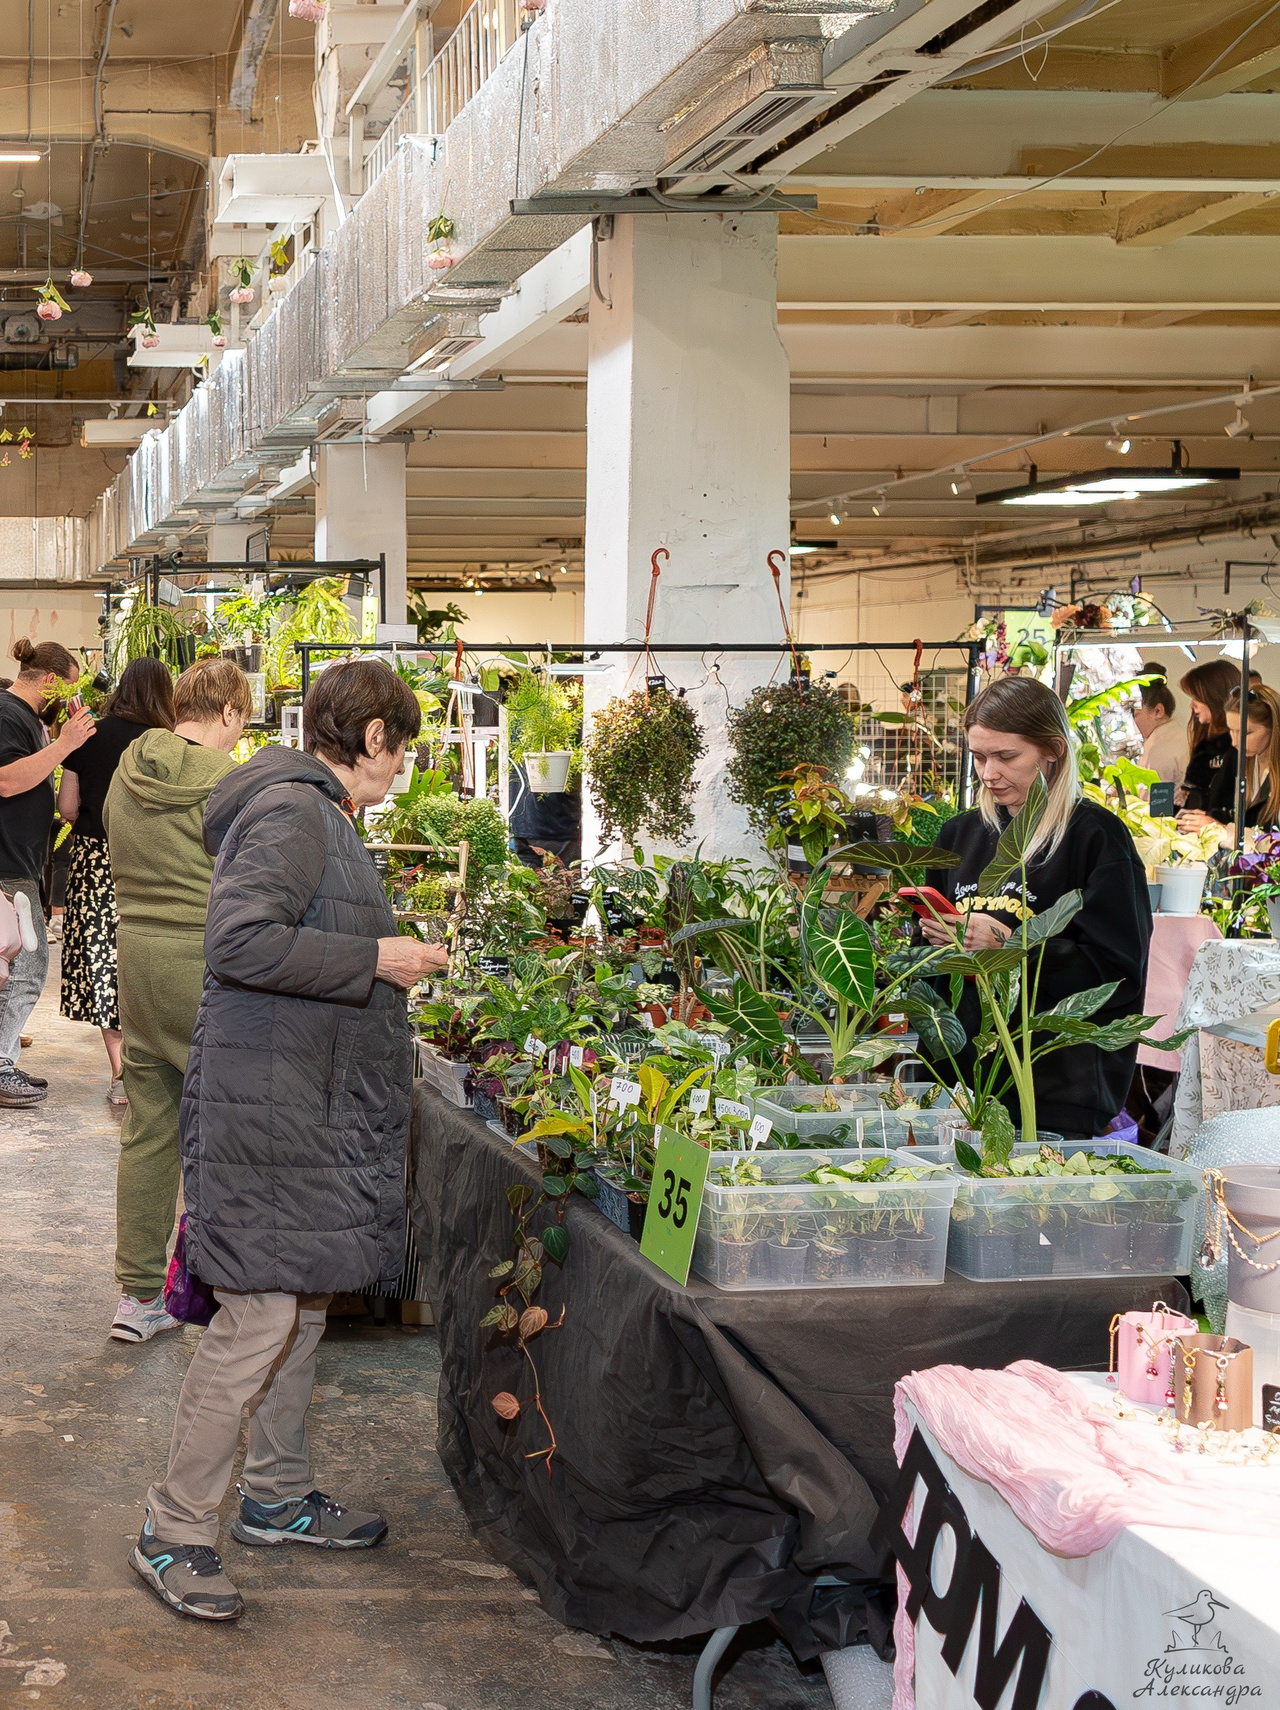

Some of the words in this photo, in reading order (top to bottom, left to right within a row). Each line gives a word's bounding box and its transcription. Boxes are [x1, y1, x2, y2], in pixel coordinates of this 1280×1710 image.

[1017, 628, 1046, 646] 25
[955, 882, 978, 900] Love
[615, 1081, 634, 1094] 700
[692, 1094, 706, 1104] 1000
[657, 1168, 692, 1229] 35
